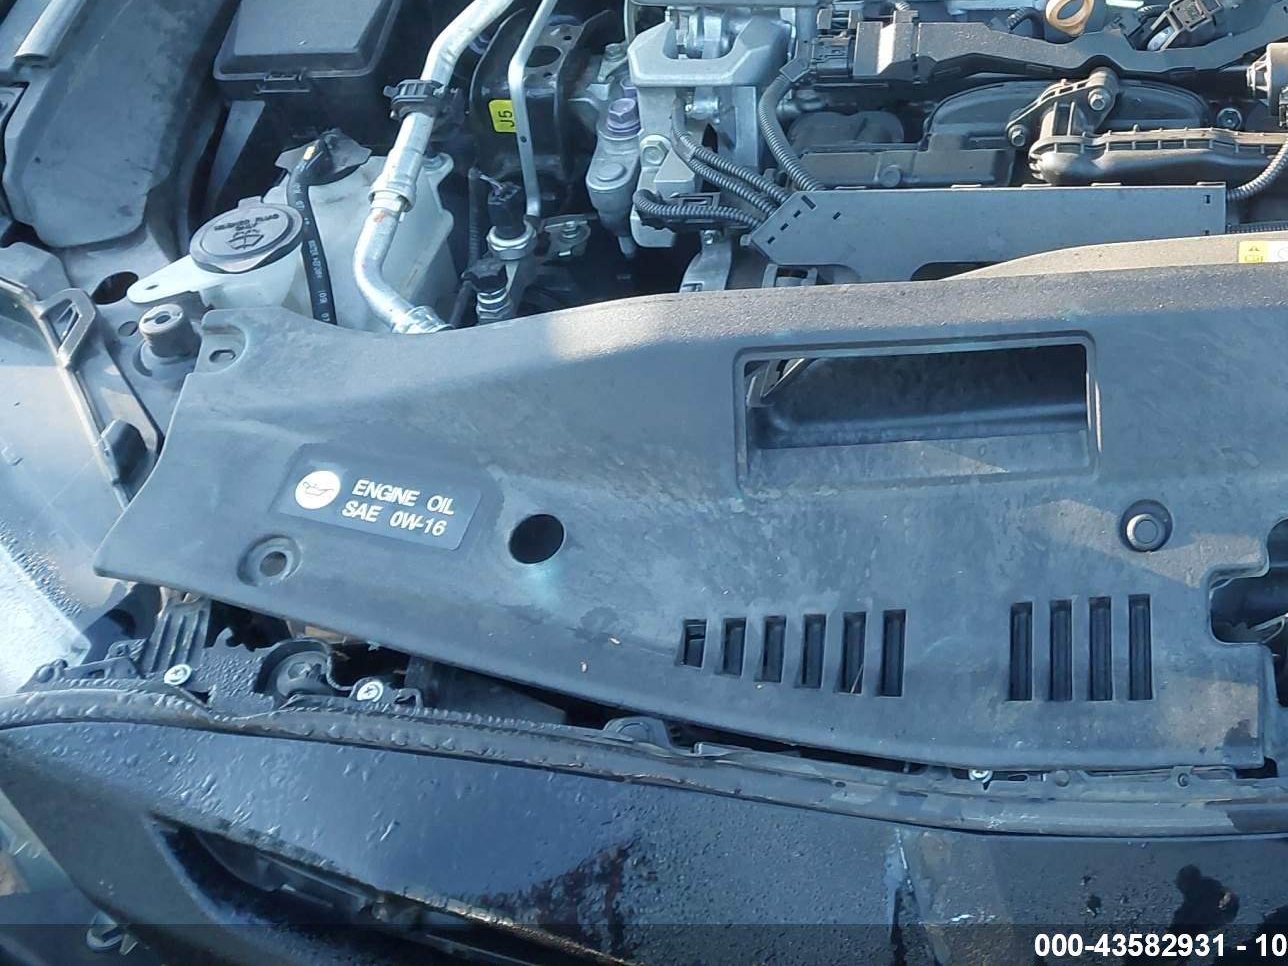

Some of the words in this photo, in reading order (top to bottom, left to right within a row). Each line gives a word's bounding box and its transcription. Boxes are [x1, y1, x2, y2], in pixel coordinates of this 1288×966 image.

[352, 479, 421, 507] ENGINE
[426, 495, 455, 516] OIL
[341, 500, 384, 523] SAE
[389, 510, 447, 537] 0W-16
